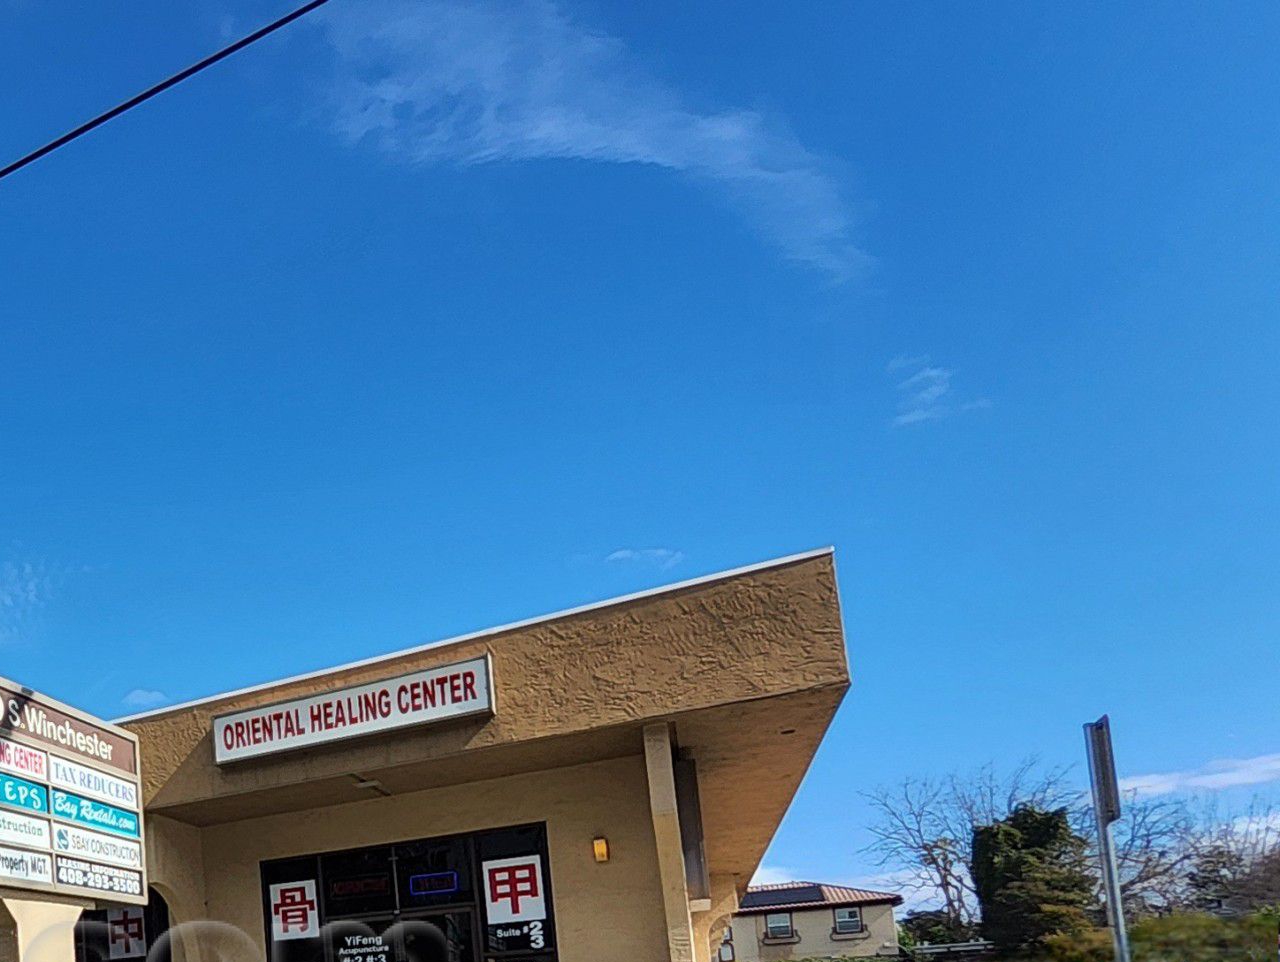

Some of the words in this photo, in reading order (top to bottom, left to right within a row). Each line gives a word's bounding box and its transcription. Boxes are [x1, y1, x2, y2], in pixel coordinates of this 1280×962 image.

[223, 709, 305, 750] ORIENTAL
[309, 688, 392, 733] HEALING
[396, 671, 478, 714] CENTER
[8, 699, 26, 729] S.
[24, 705, 113, 760] Winchester
[13, 747, 44, 775] CENTER
[53, 761, 77, 785] TAX
[79, 771, 135, 802] REDUCERS
[53, 792, 78, 820] Bay
[71, 834, 90, 851] SBAY
[58, 867, 141, 894] 408-293-3500
[273, 886, 316, 933] 骨
[110, 910, 143, 953] 中
[344, 935, 383, 946] YiFeng
[496, 928, 521, 938] Suite
[338, 945, 389, 955] Acupuncture
